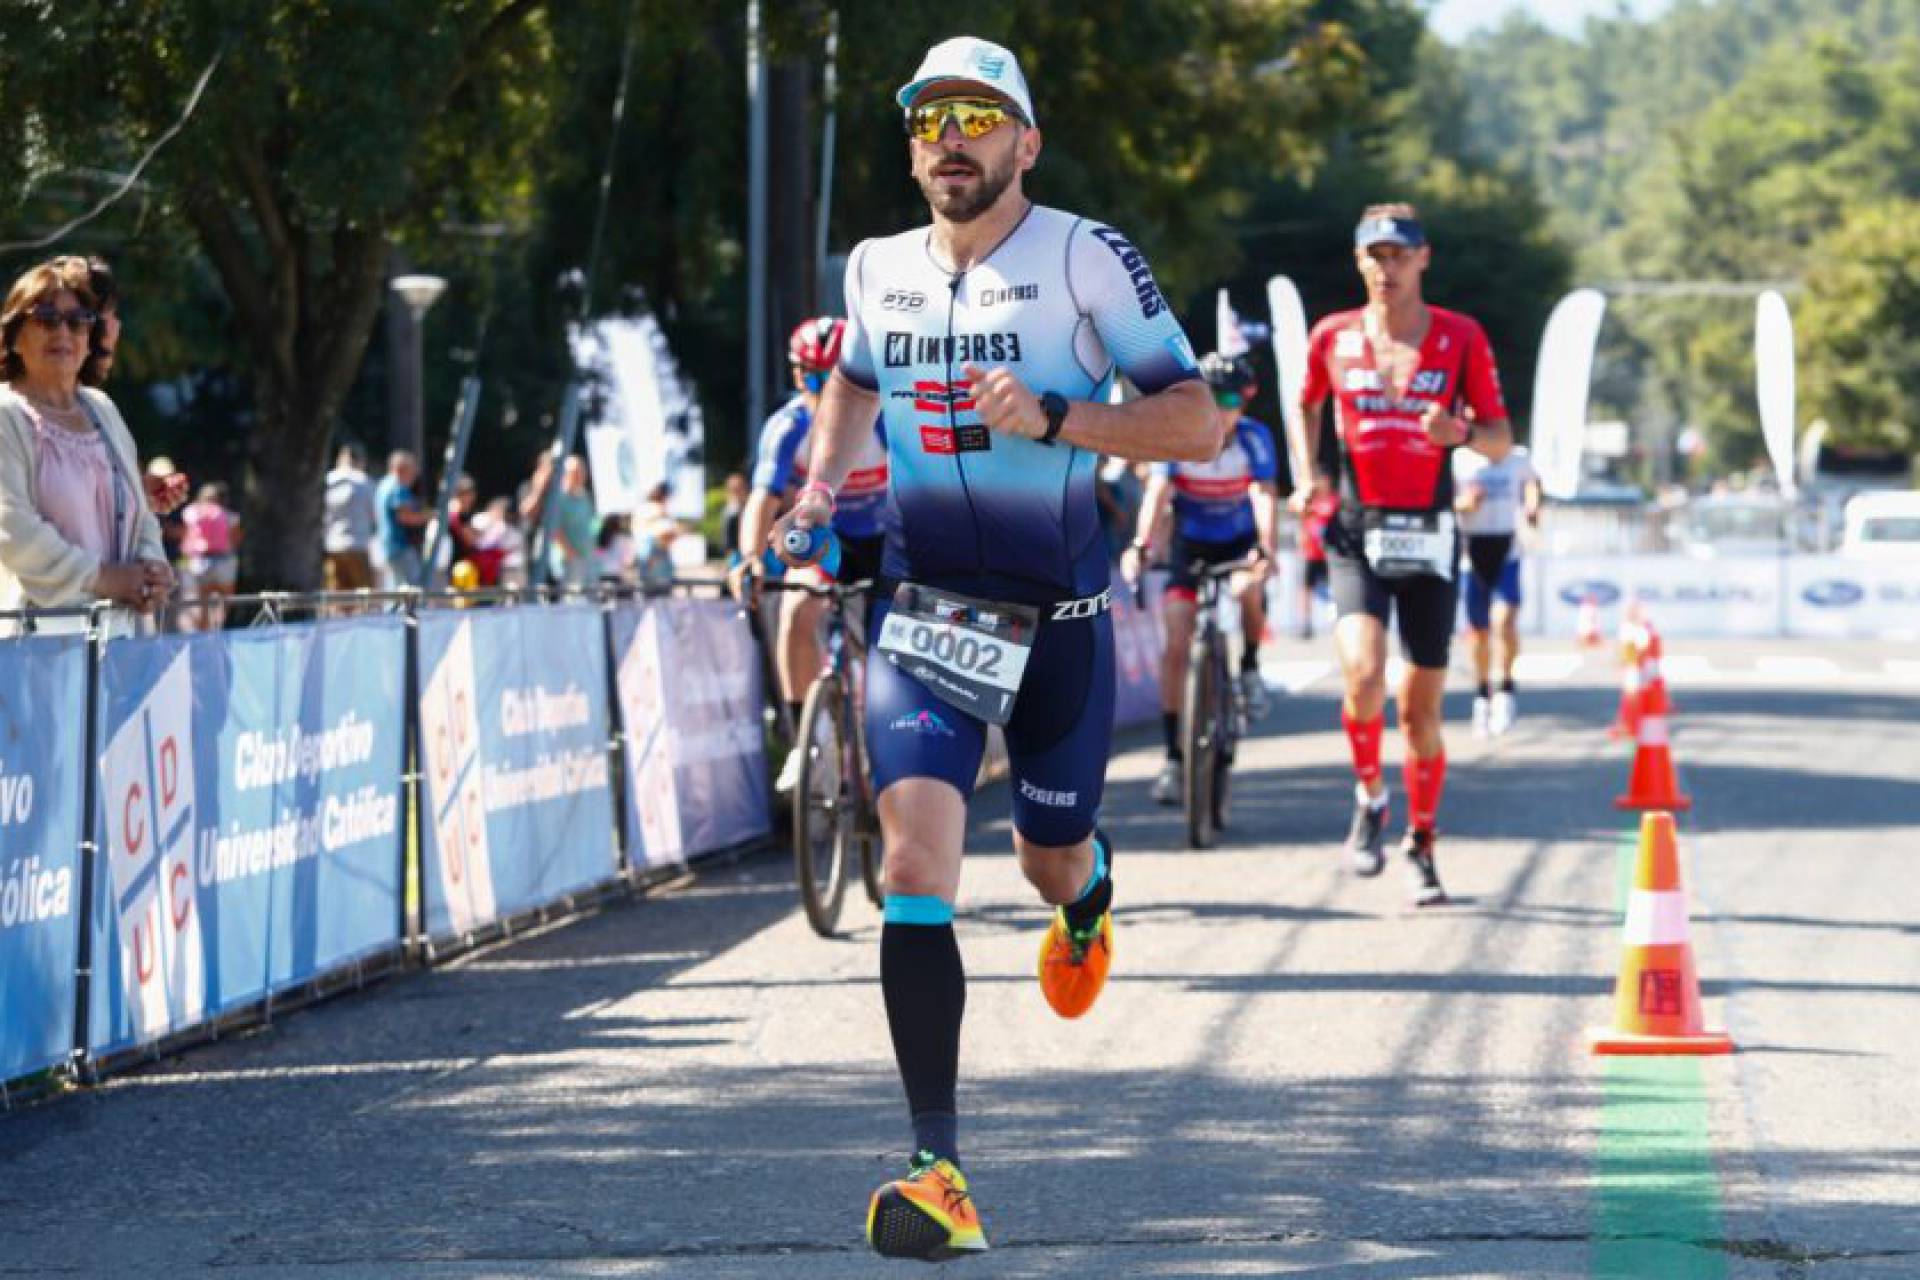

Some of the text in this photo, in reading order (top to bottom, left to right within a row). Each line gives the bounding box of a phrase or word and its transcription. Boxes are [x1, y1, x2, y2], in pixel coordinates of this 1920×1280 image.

[911, 625, 1003, 678] 0002
[235, 710, 374, 790] Club Deportivo
[199, 784, 396, 887] Universidad Católica
[0, 854, 71, 928] ólica
